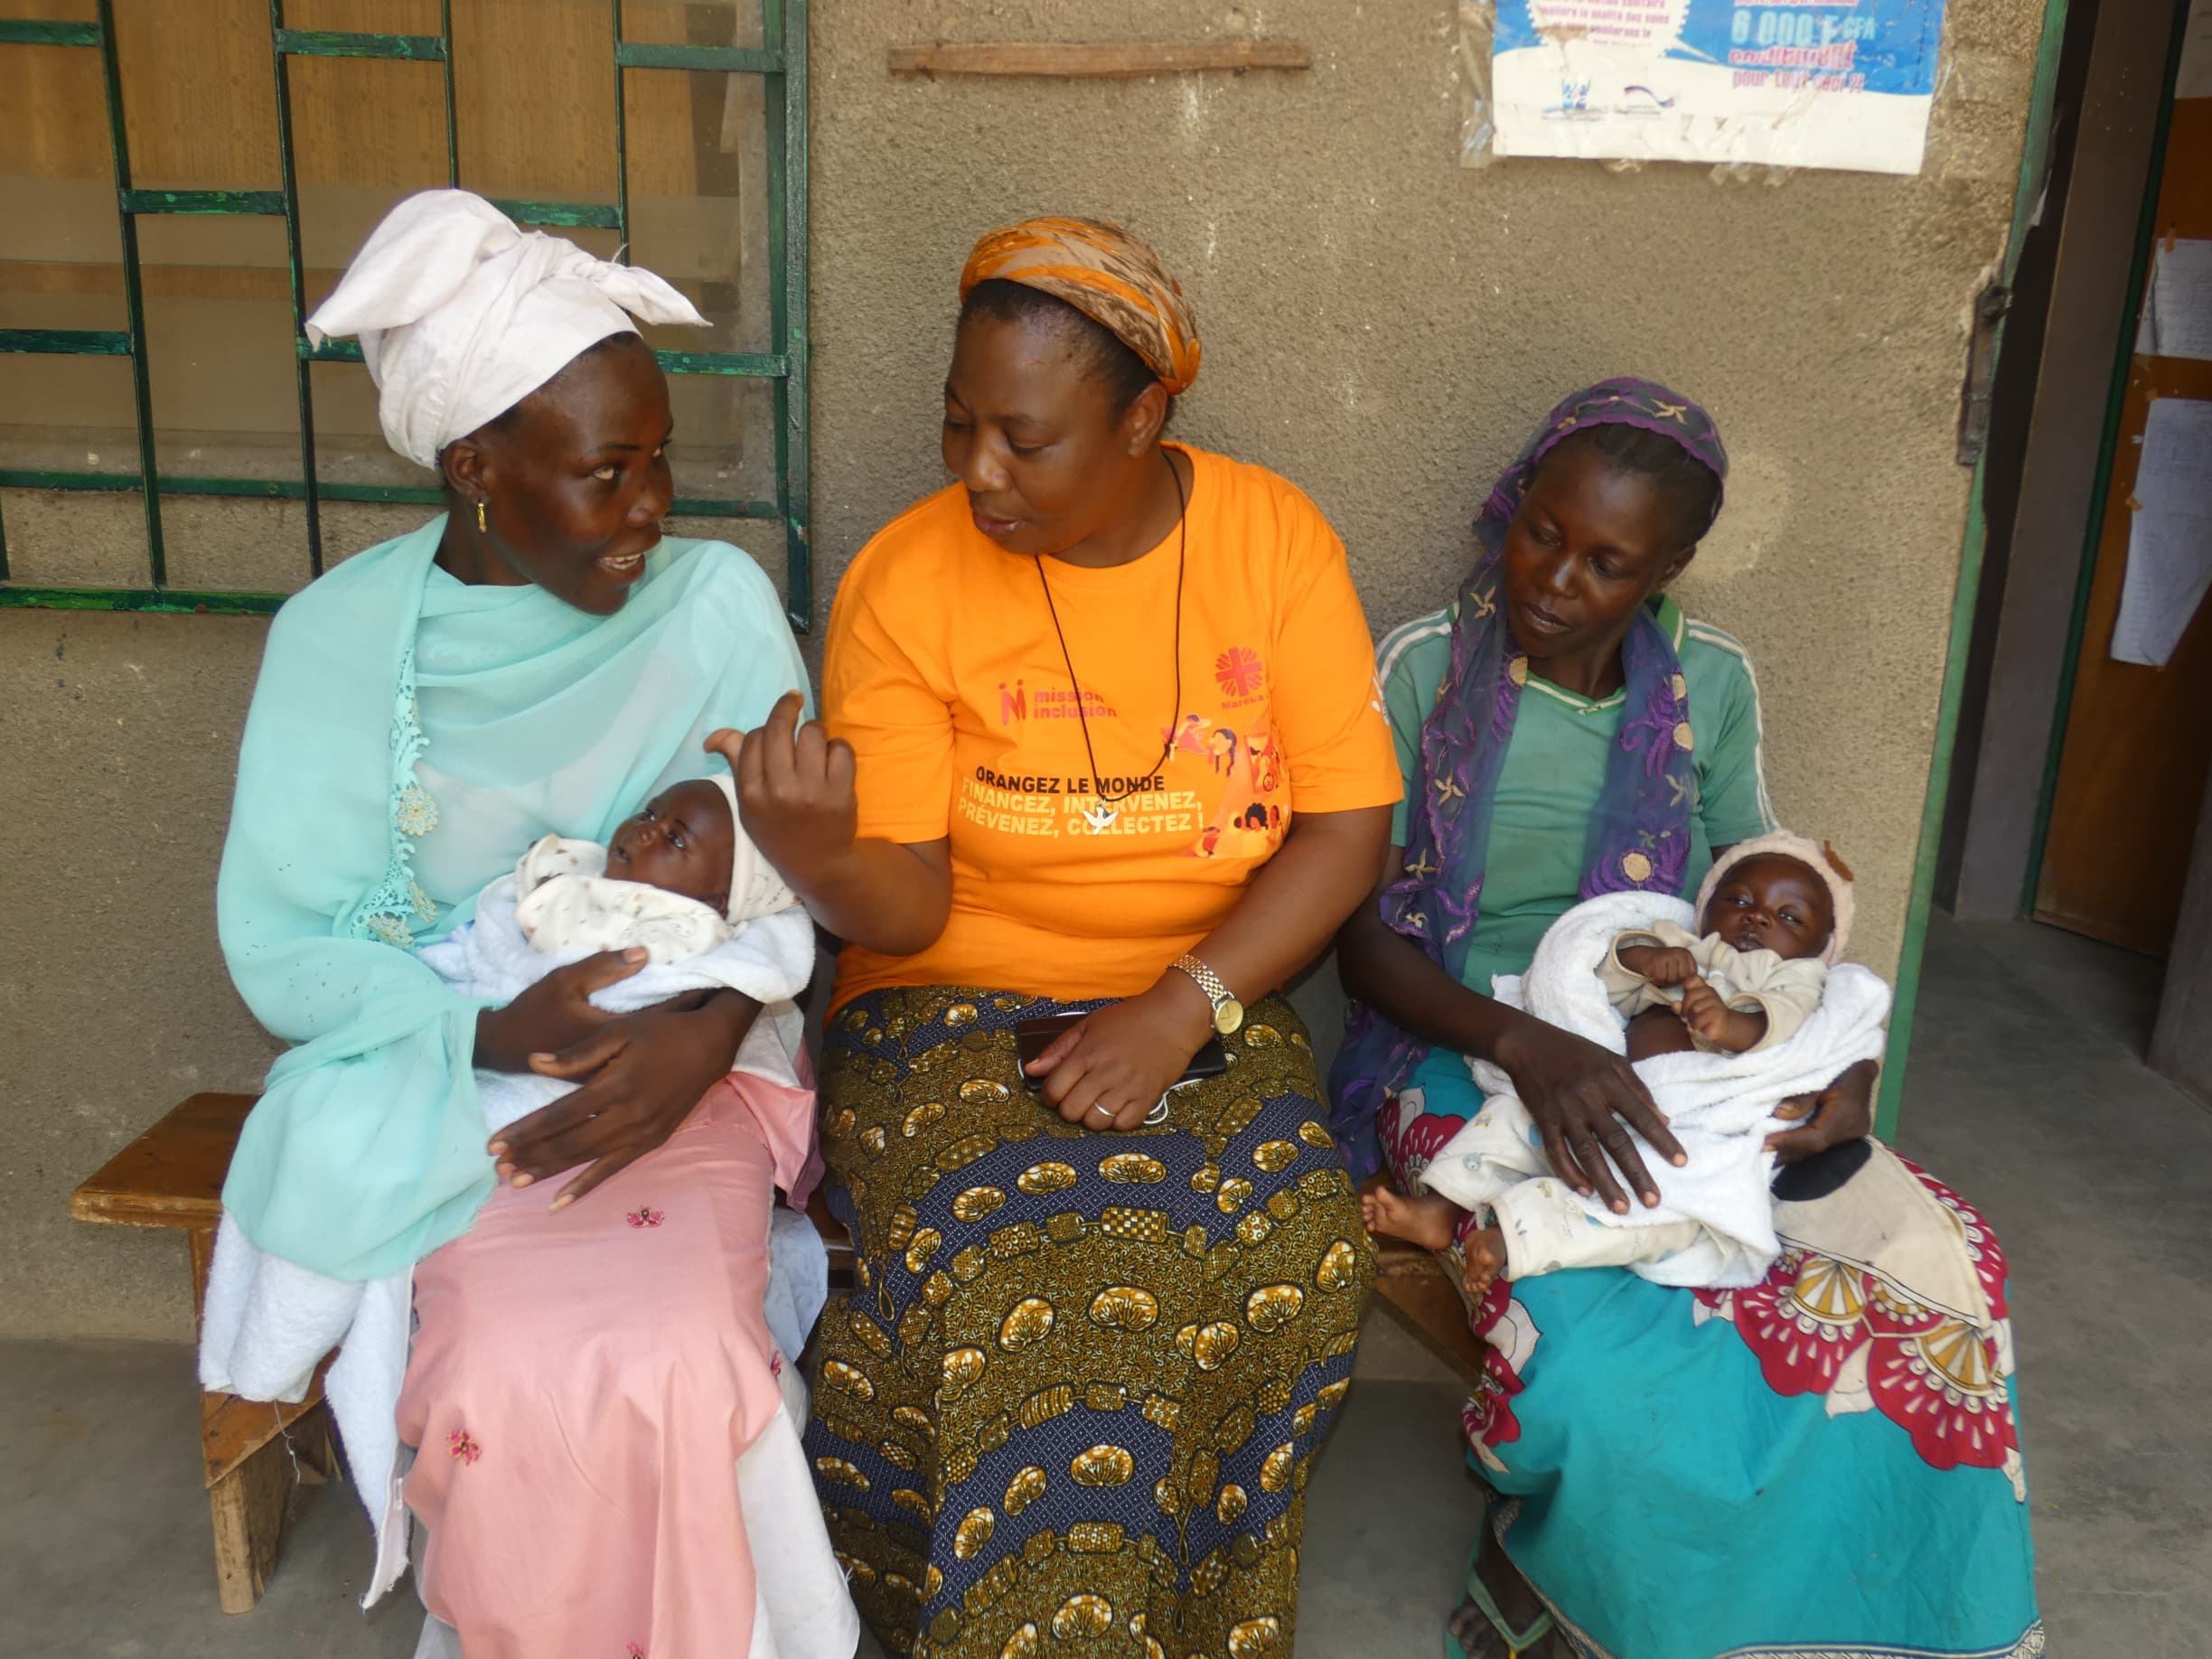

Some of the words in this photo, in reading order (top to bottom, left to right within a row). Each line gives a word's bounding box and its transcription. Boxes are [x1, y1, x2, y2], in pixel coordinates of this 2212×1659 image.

[1732, 70, 1769, 89] pour
[1033, 703, 1118, 719] inclusion
[976, 765, 1061, 794] ORANGEZ
[1067, 778, 1090, 794] LE
[1096, 775, 1166, 794] MONDE
[961, 777, 1056, 817] FINANCEZ,
[957, 796, 1059, 839] PRÉVENEZ,
